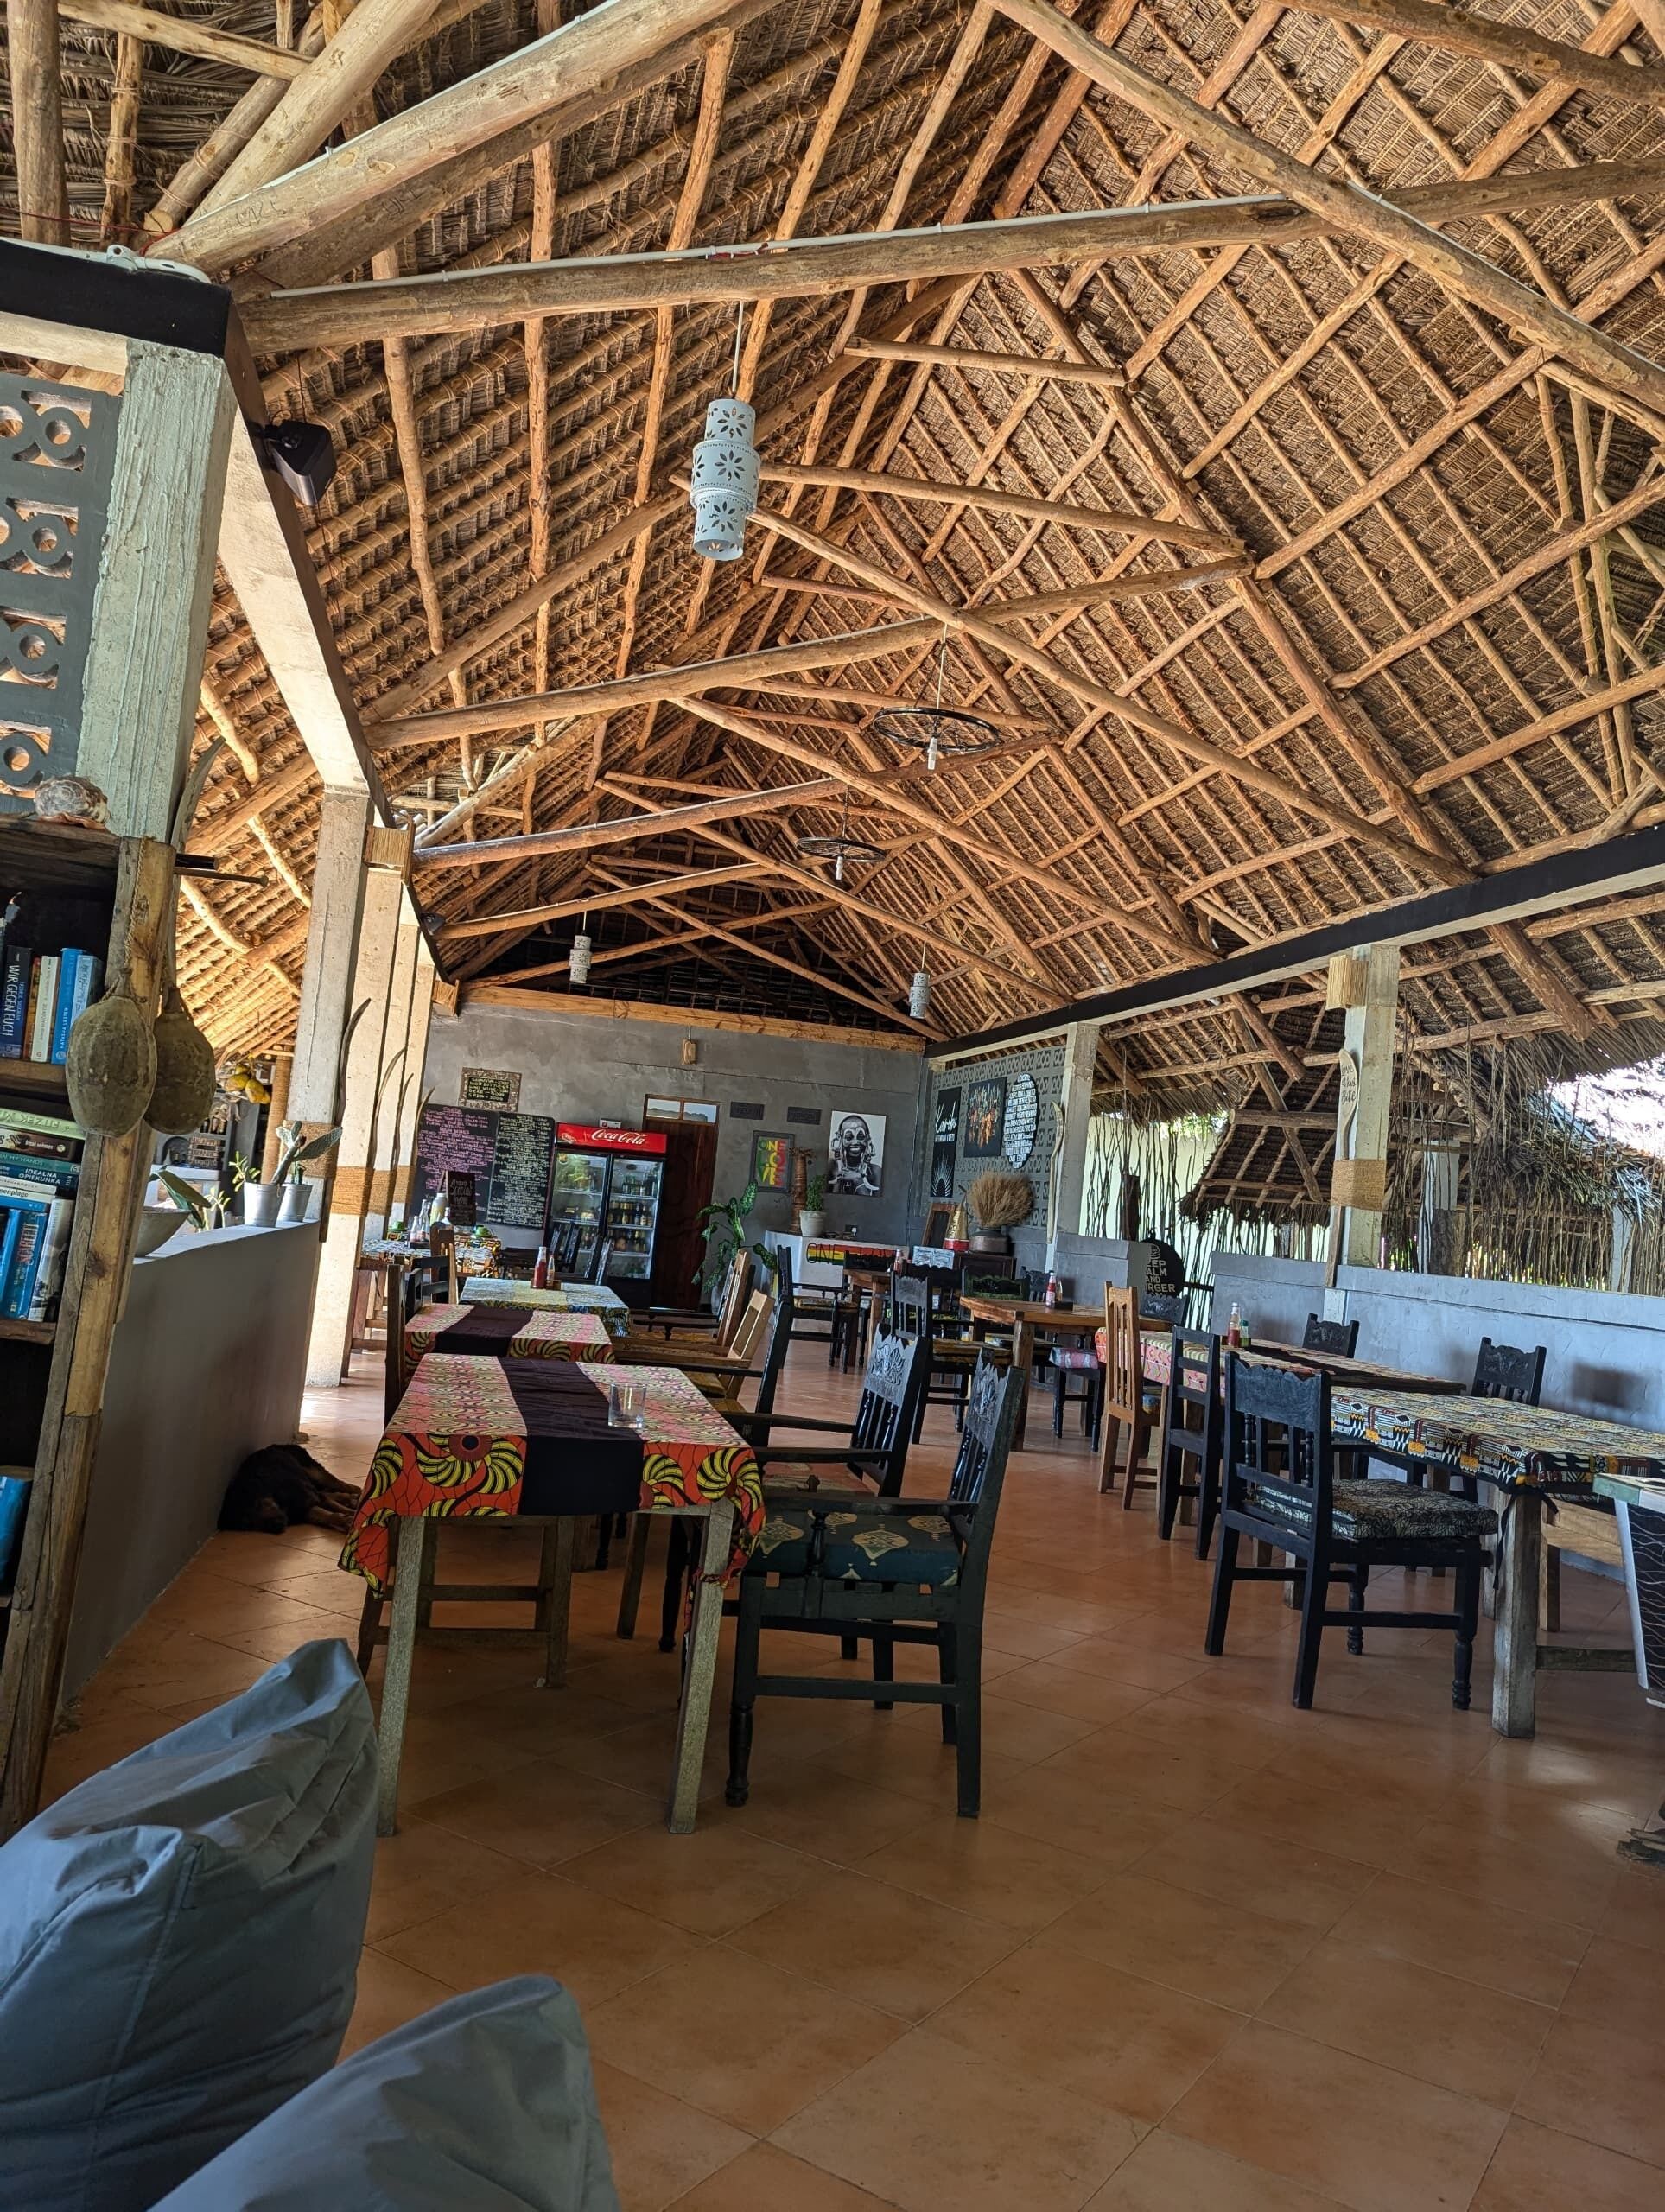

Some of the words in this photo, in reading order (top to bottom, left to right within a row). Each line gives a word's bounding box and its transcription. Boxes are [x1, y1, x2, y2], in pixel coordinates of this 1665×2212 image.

[9, 964, 21, 983] WIR
[4, 984, 18, 1014] GEGEN
[2, 1013, 15, 1036] EUCH
[21, 1115, 60, 1128] FITZEK
[591, 1128, 648, 1145] Coca-Cola
[759, 1139, 787, 1152] ONE
[18, 1173, 60, 1185] OPIEKUNKA
[25, 1168, 57, 1179] IDEALNA
[1146, 1267, 1167, 1276] ALM
[1146, 1283, 1176, 1292] RGER
